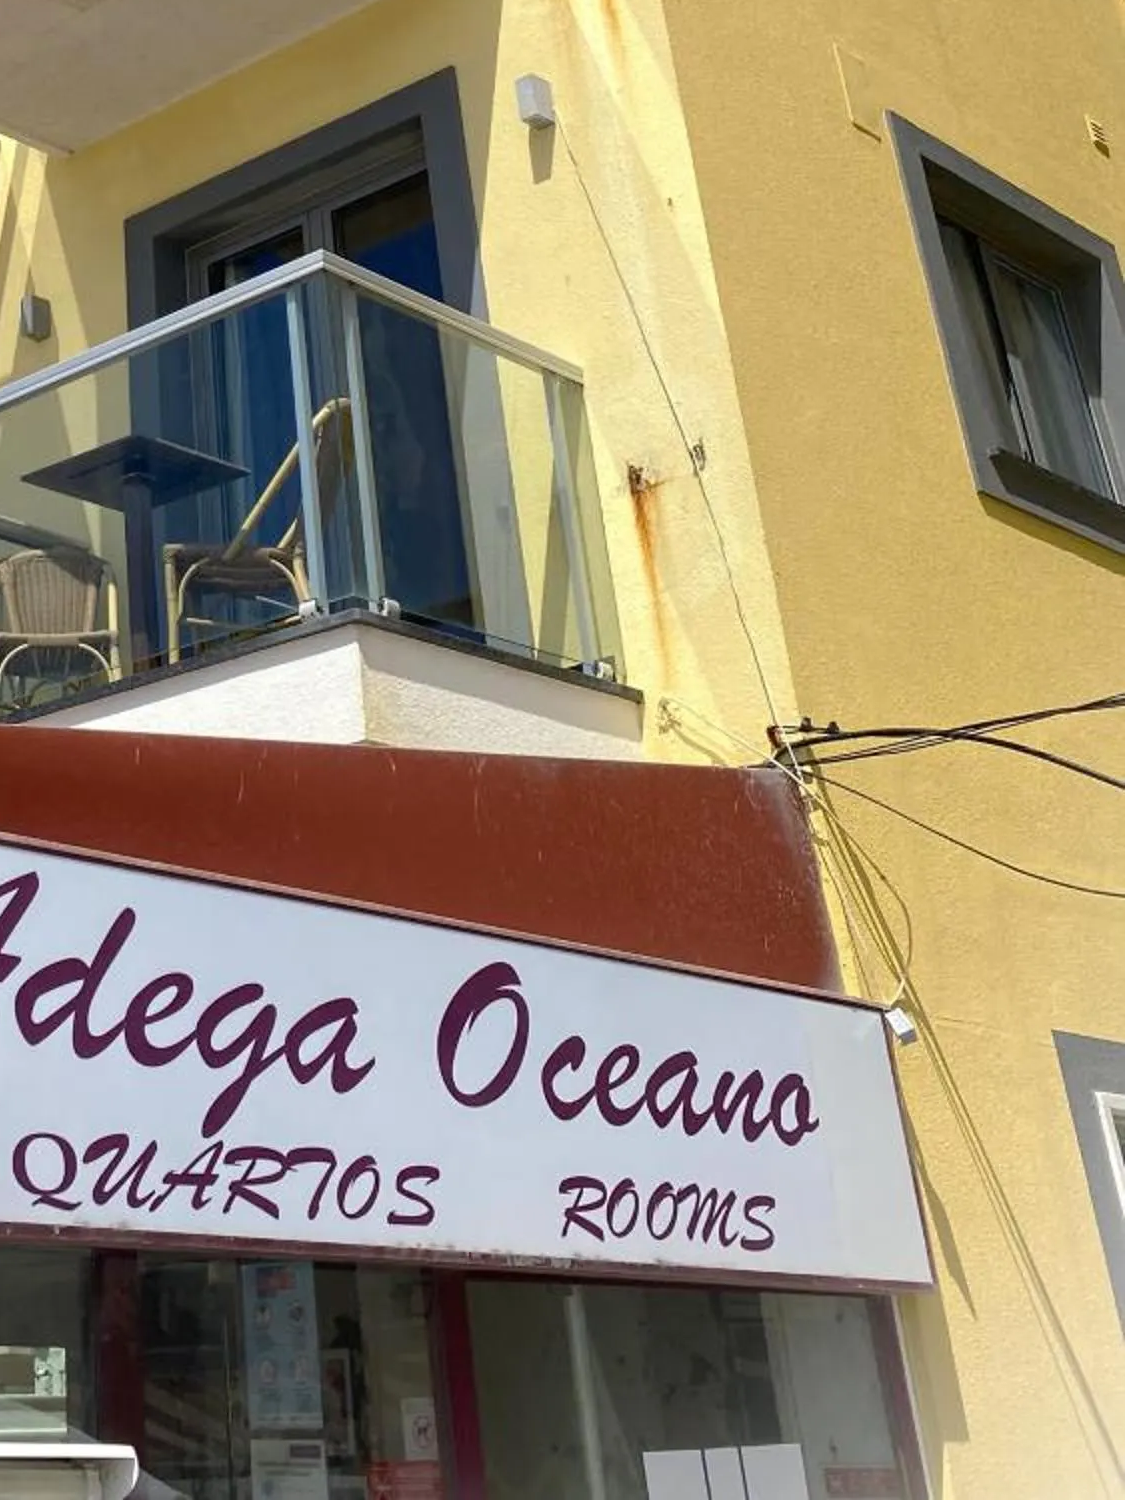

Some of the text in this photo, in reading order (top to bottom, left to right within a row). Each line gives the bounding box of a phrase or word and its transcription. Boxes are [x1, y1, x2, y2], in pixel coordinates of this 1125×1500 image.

[436, 961, 820, 1148] Oceano
[11, 1131, 776, 1252] QUARTOS ROOMS
